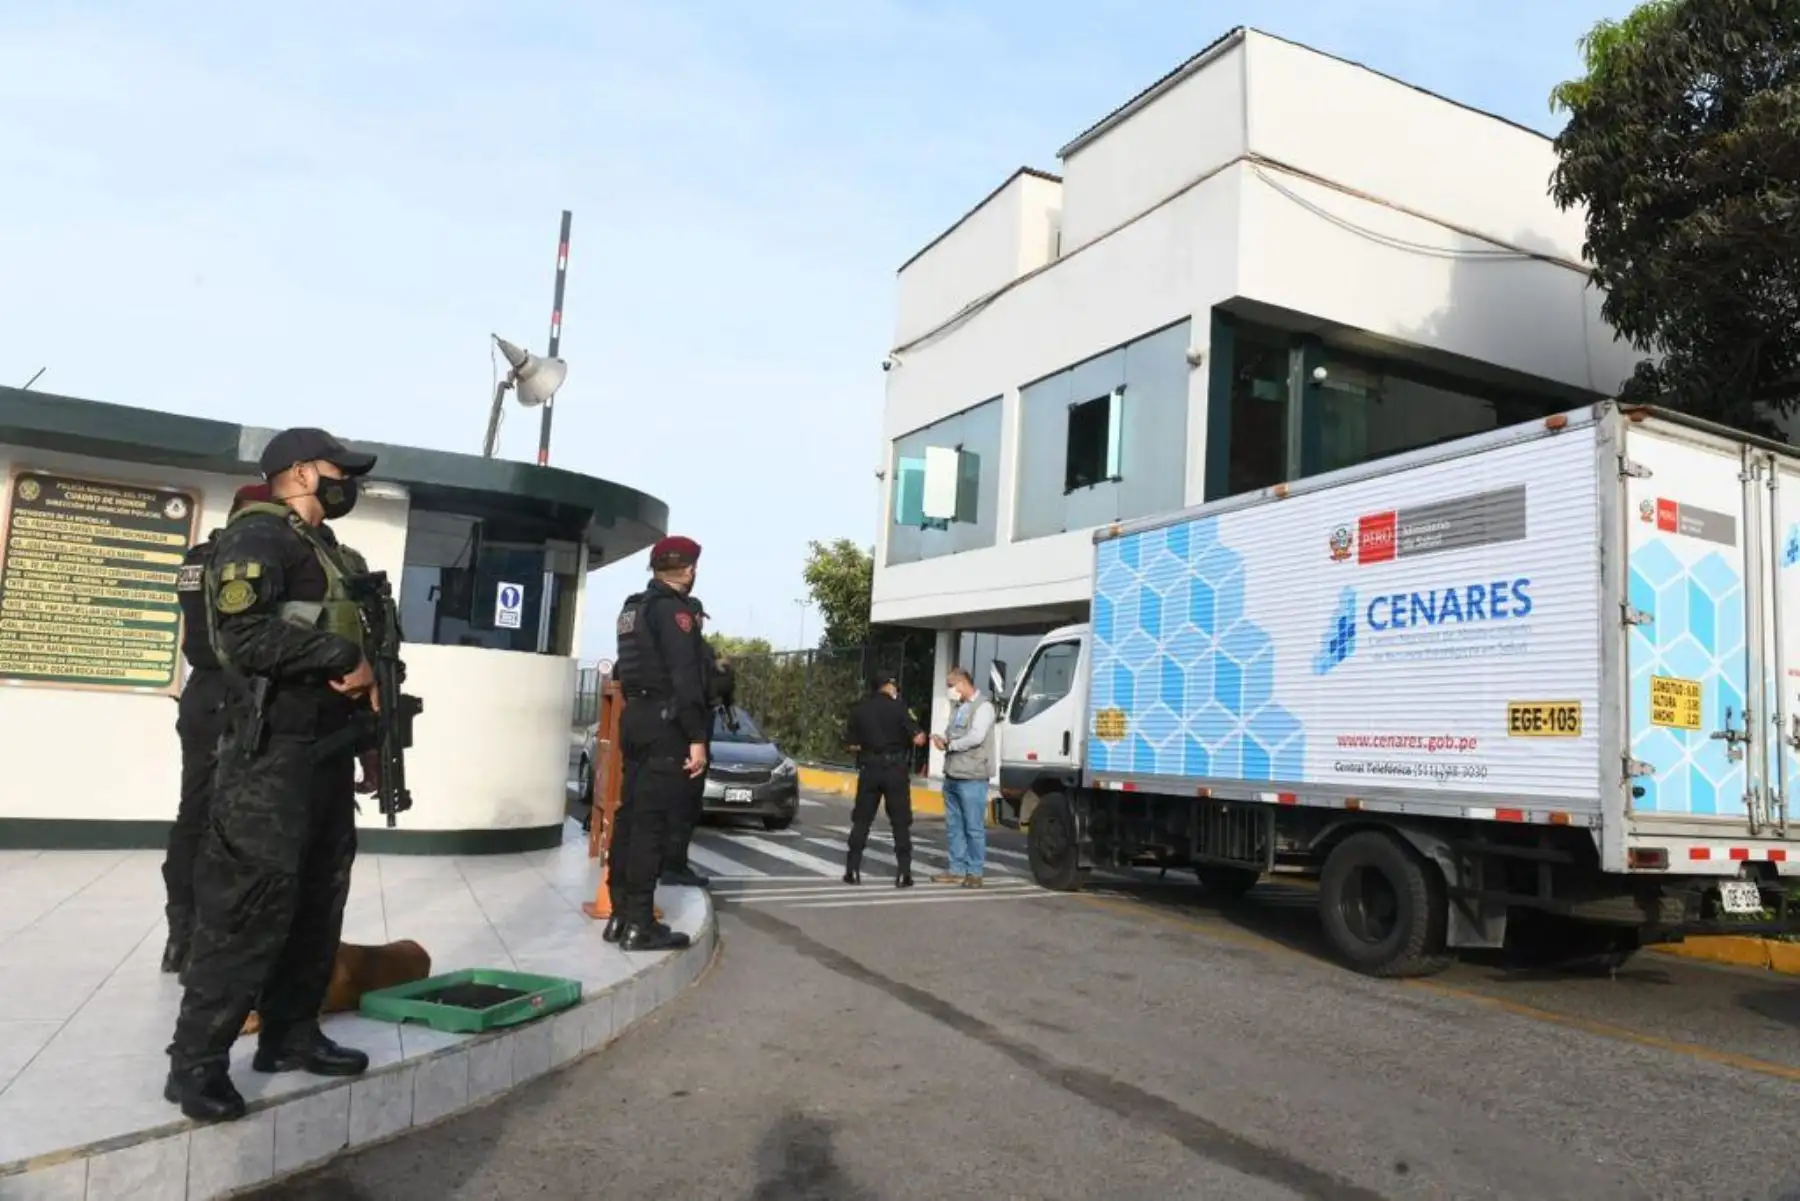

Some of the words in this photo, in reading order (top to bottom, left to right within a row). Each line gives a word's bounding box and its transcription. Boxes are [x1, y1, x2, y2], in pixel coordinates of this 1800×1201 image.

[1367, 577, 1533, 632] CENARES
[1511, 706, 1577, 732] EGE-105
[1337, 733, 1477, 752] www.cenares.gob.pe
